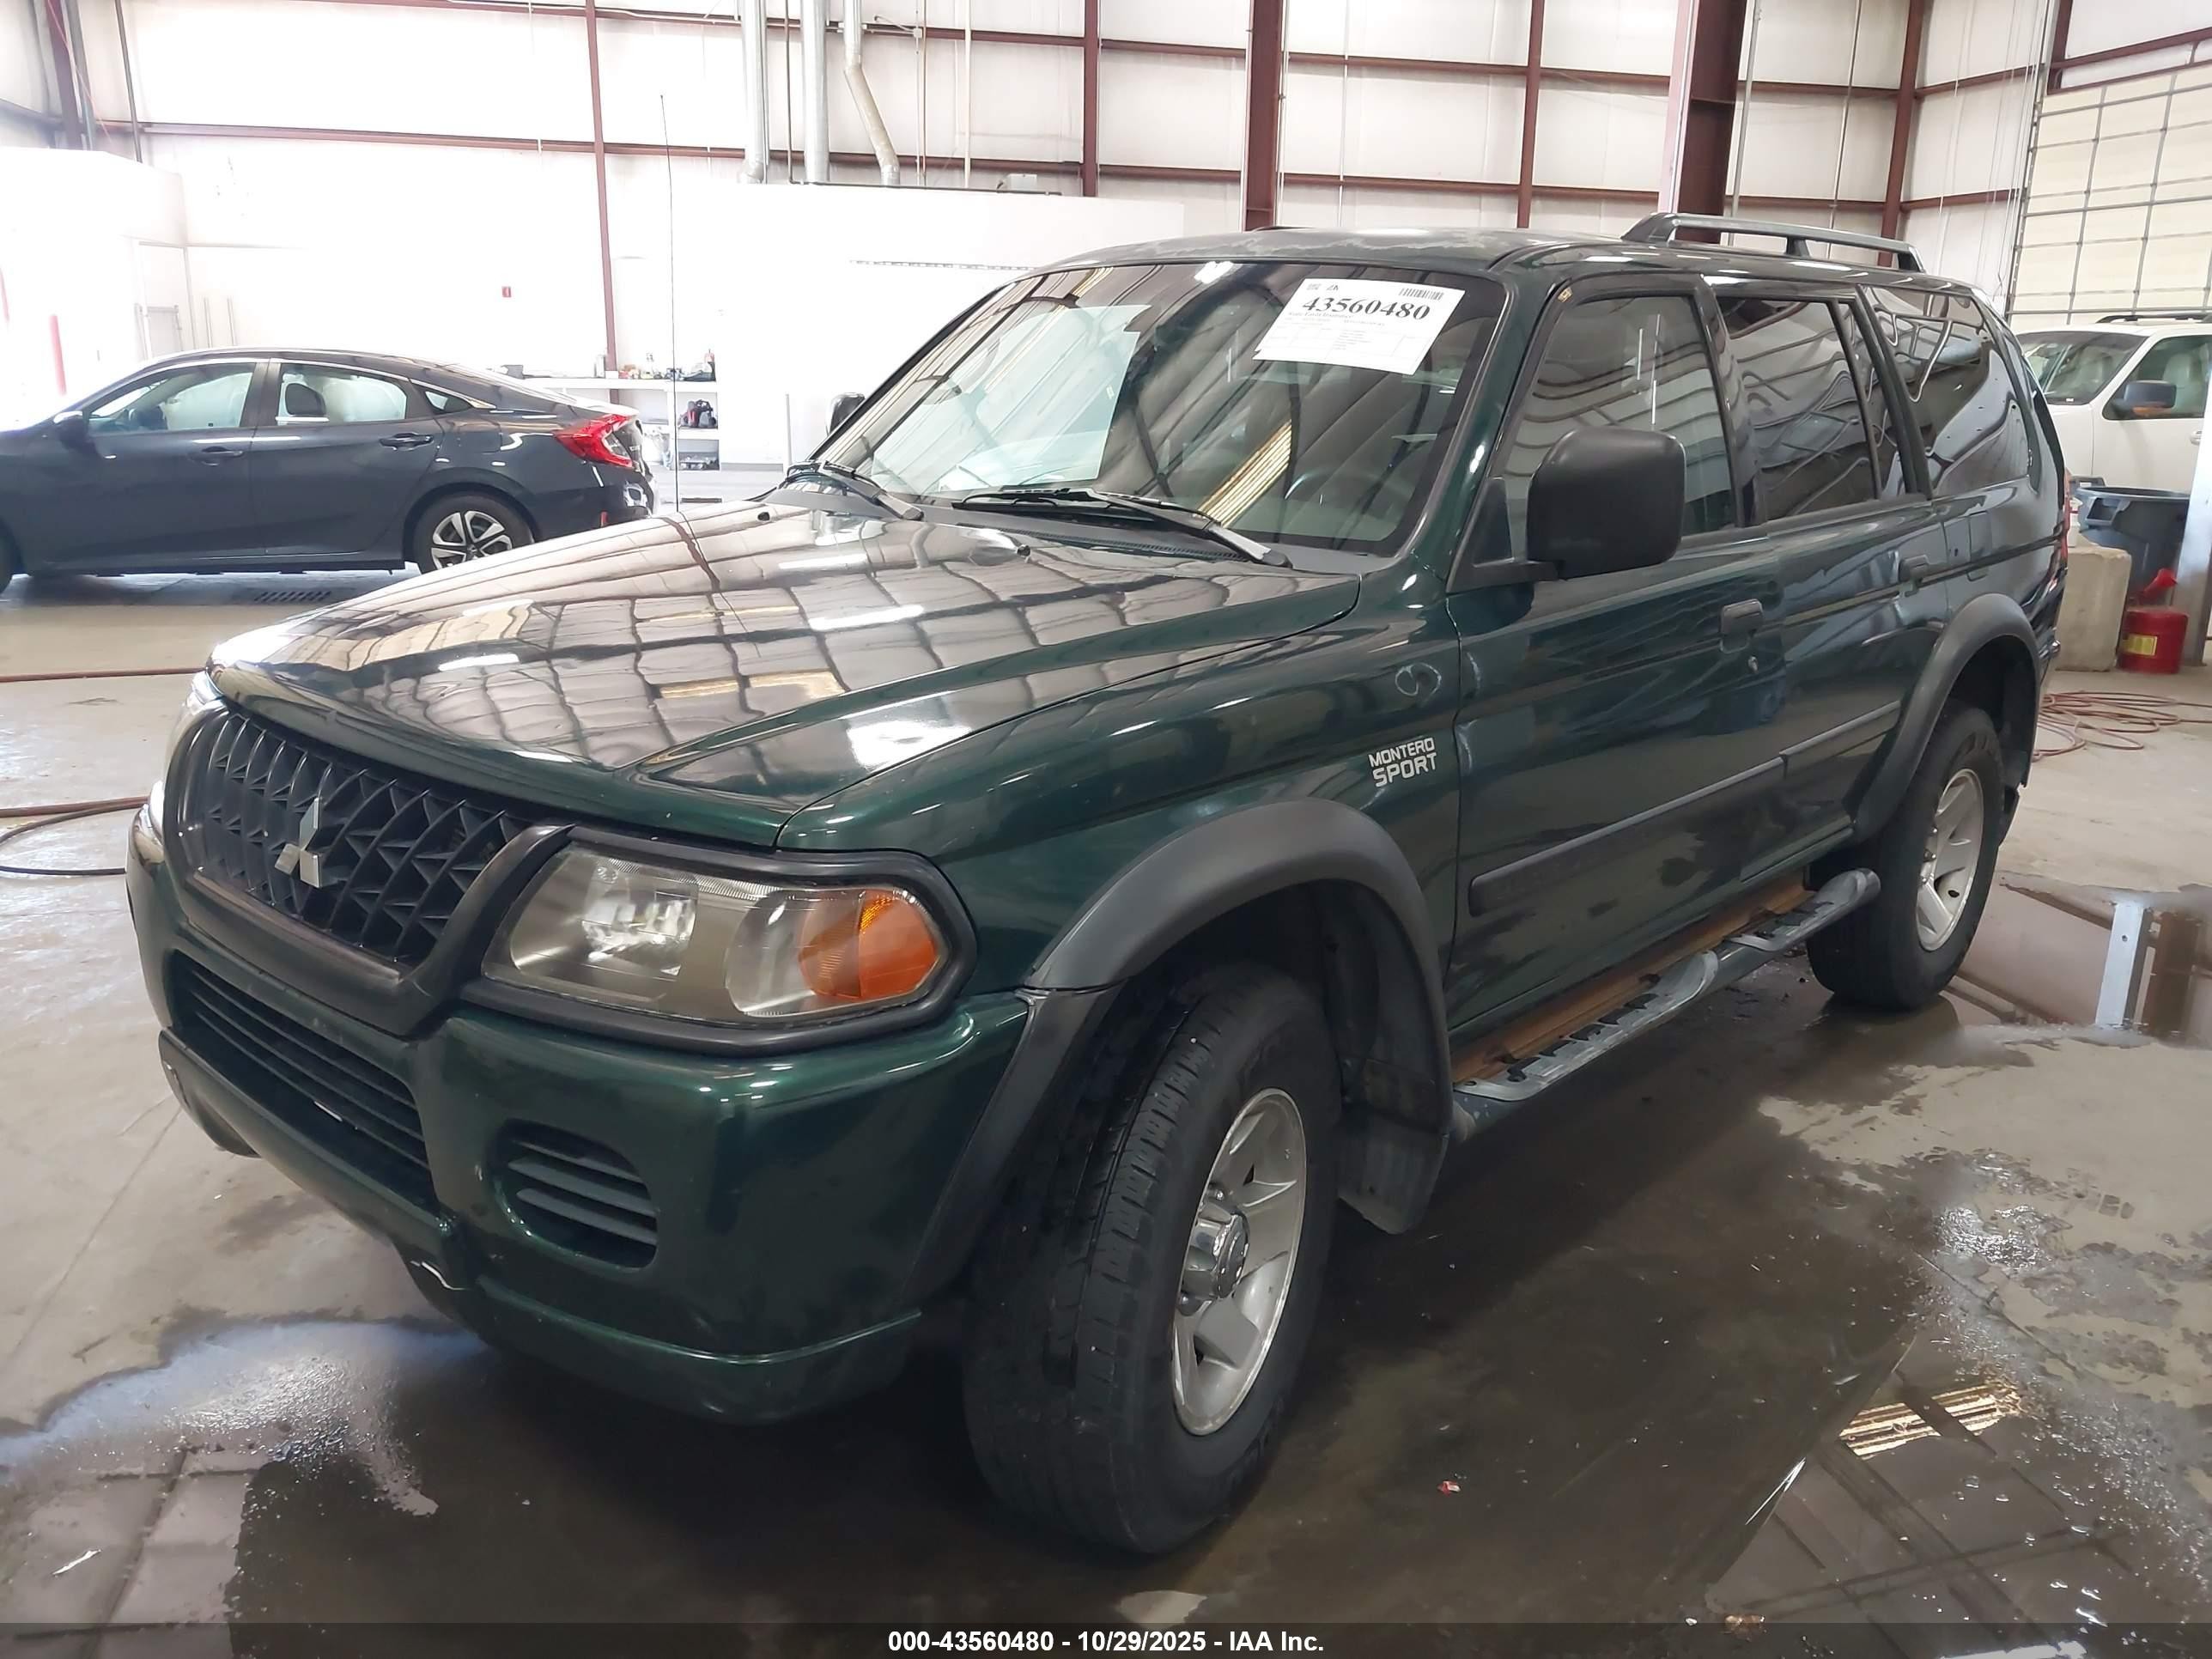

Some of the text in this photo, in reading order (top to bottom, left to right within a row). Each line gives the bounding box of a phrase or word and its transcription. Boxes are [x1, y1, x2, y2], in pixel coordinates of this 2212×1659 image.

[1302, 296, 1431, 320] 43560480
[1369, 738, 1436, 767] MONTERO
[1372, 752, 1437, 787] SPORT
